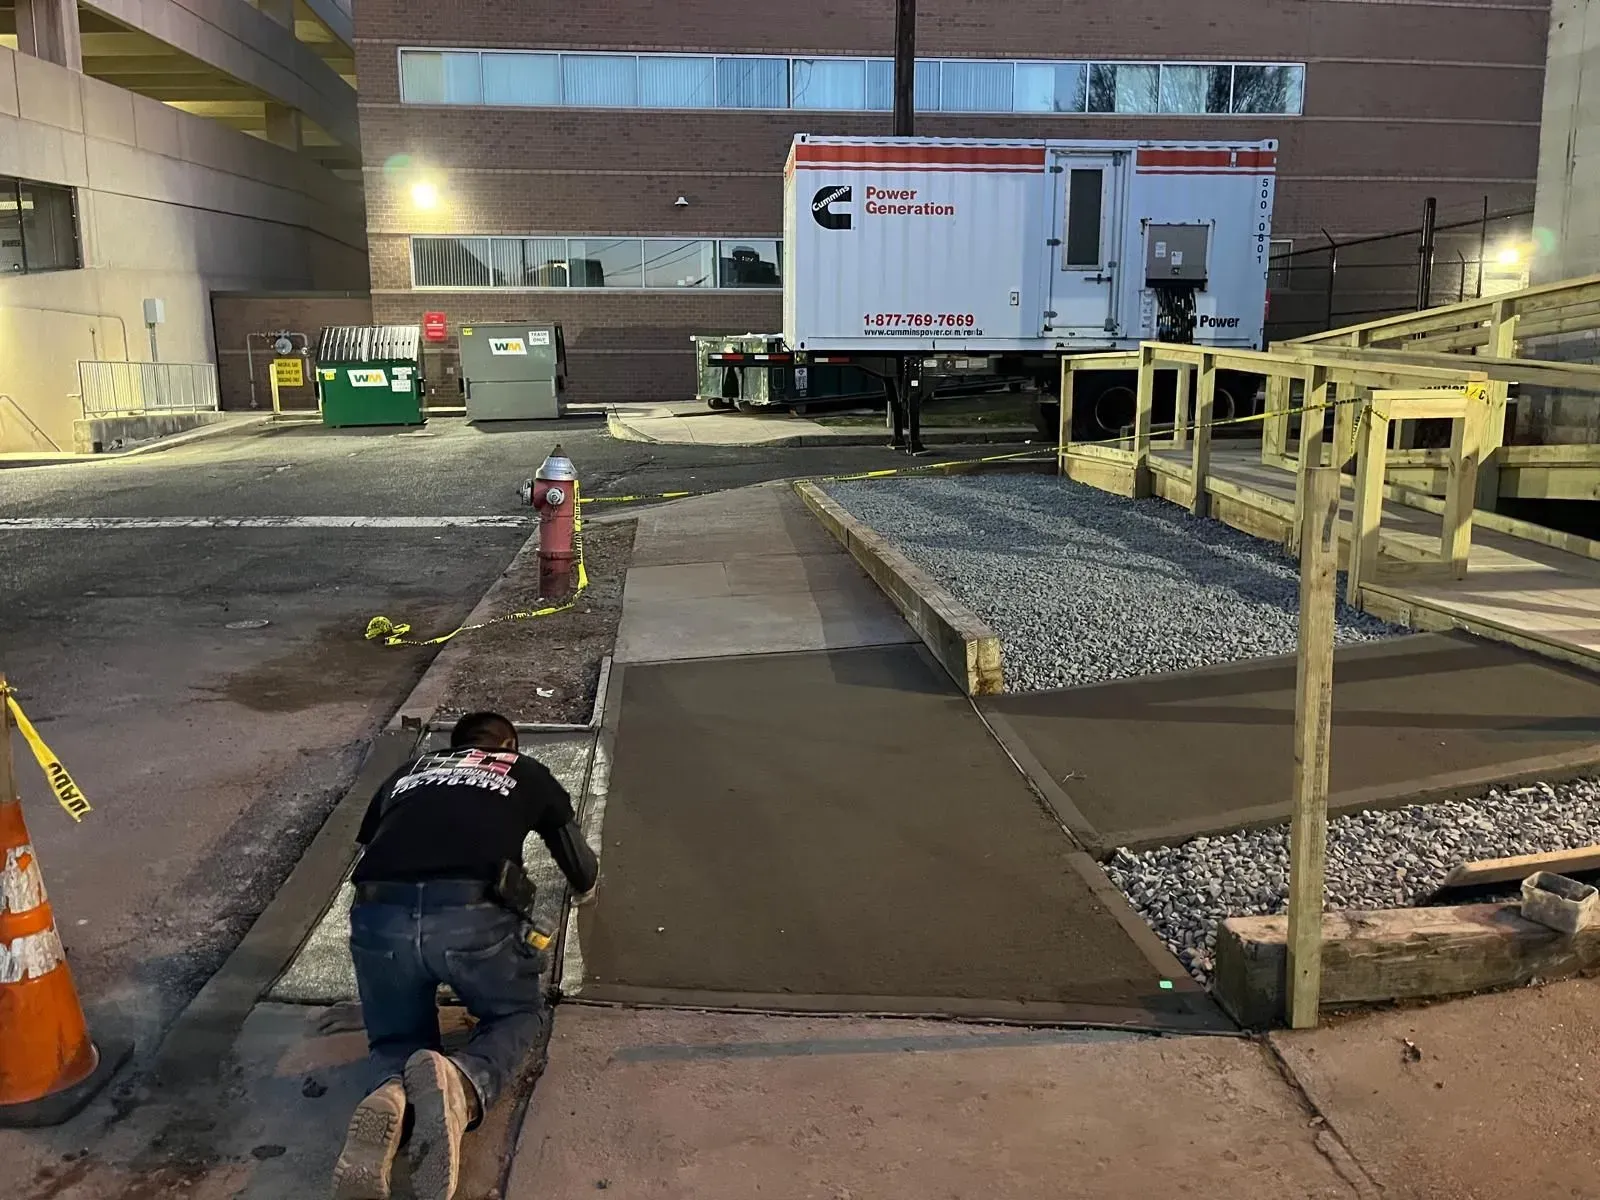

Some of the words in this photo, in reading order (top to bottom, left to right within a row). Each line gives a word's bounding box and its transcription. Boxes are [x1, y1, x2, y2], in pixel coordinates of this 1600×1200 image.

[812, 185, 850, 212] Cummins
[866, 186, 917, 200] Power
[865, 201, 954, 216] Generation
[863, 313, 974, 327] 1-877-769-7669
[1199, 314, 1240, 328] Power
[494, 342, 522, 351] WM
[354, 374, 383, 383] WM
